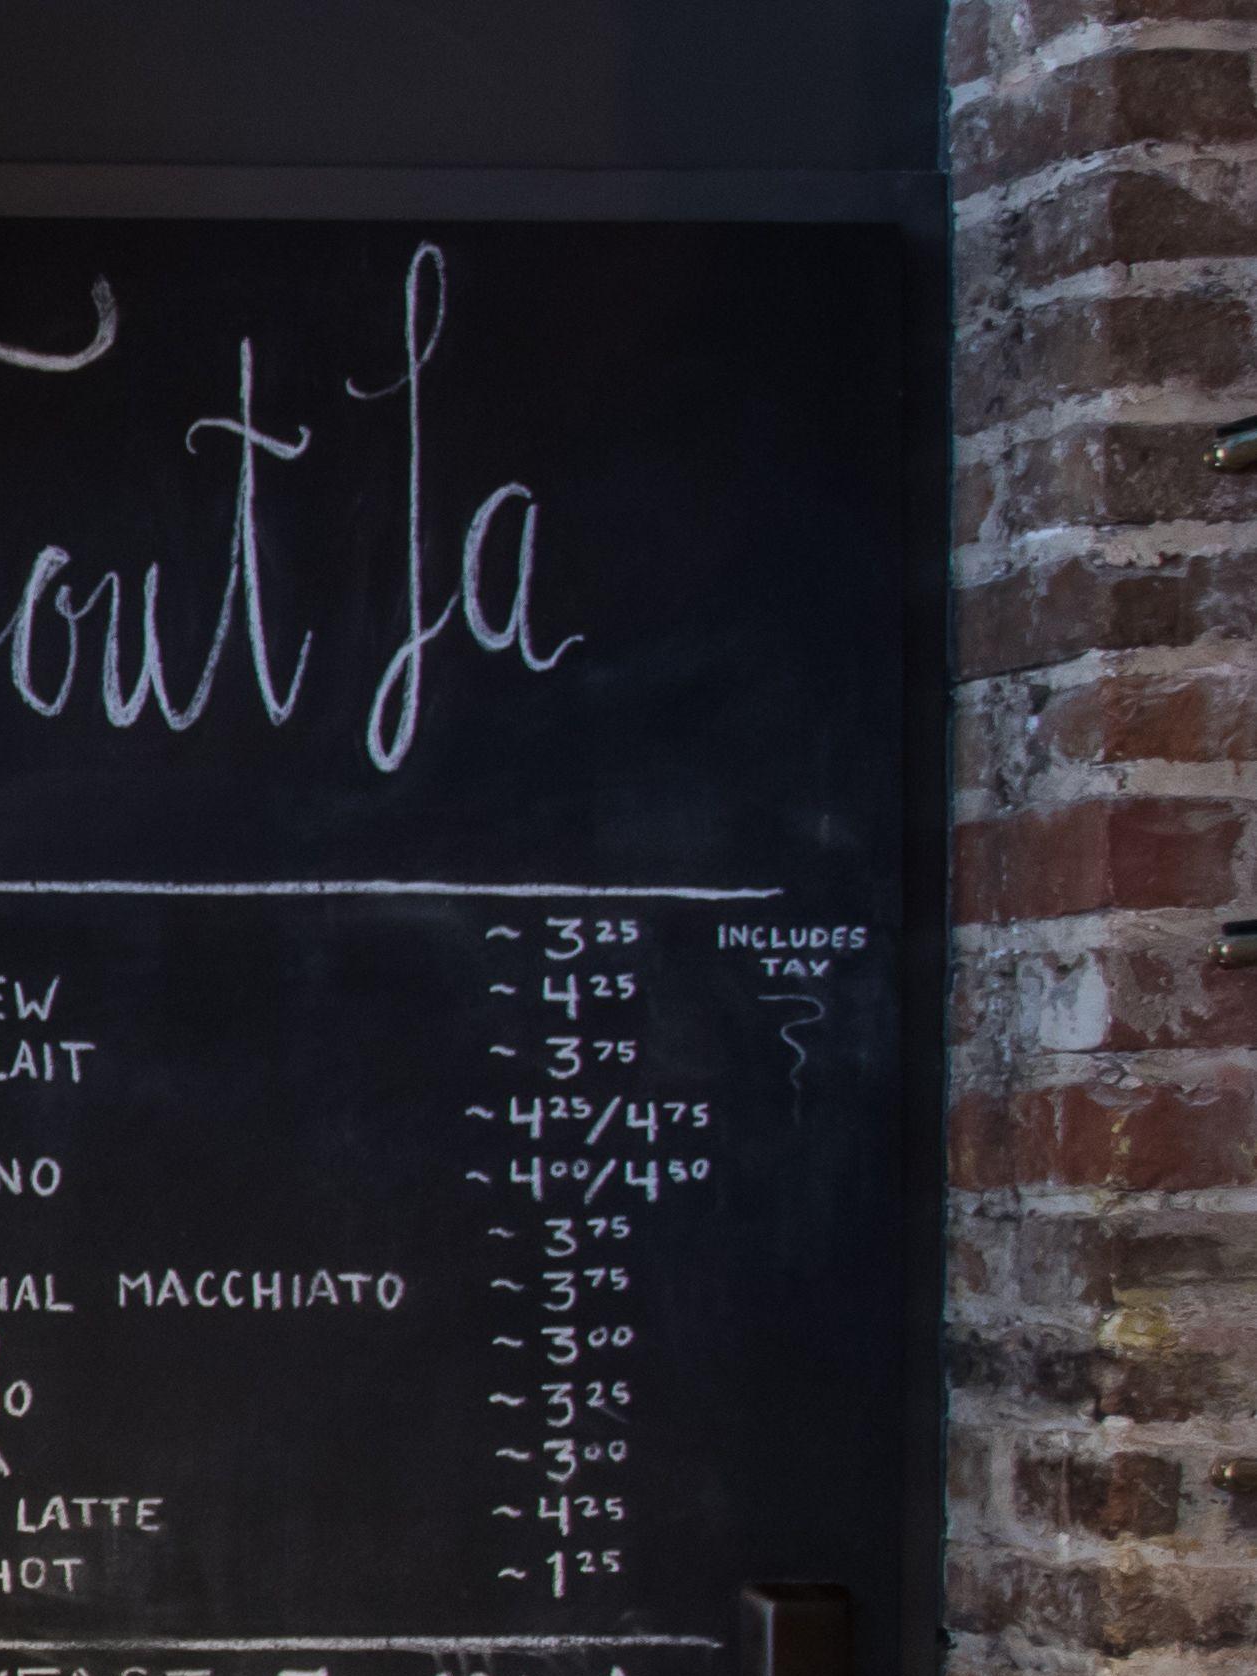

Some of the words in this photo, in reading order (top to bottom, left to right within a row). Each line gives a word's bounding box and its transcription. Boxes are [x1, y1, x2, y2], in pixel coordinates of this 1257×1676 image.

[717, 923, 868, 950] INCLUDES
[759, 957, 831, 978] TAX
[118, 1269, 405, 1311] MACCHIATO
[16, 1496, 164, 1534] LATTE
